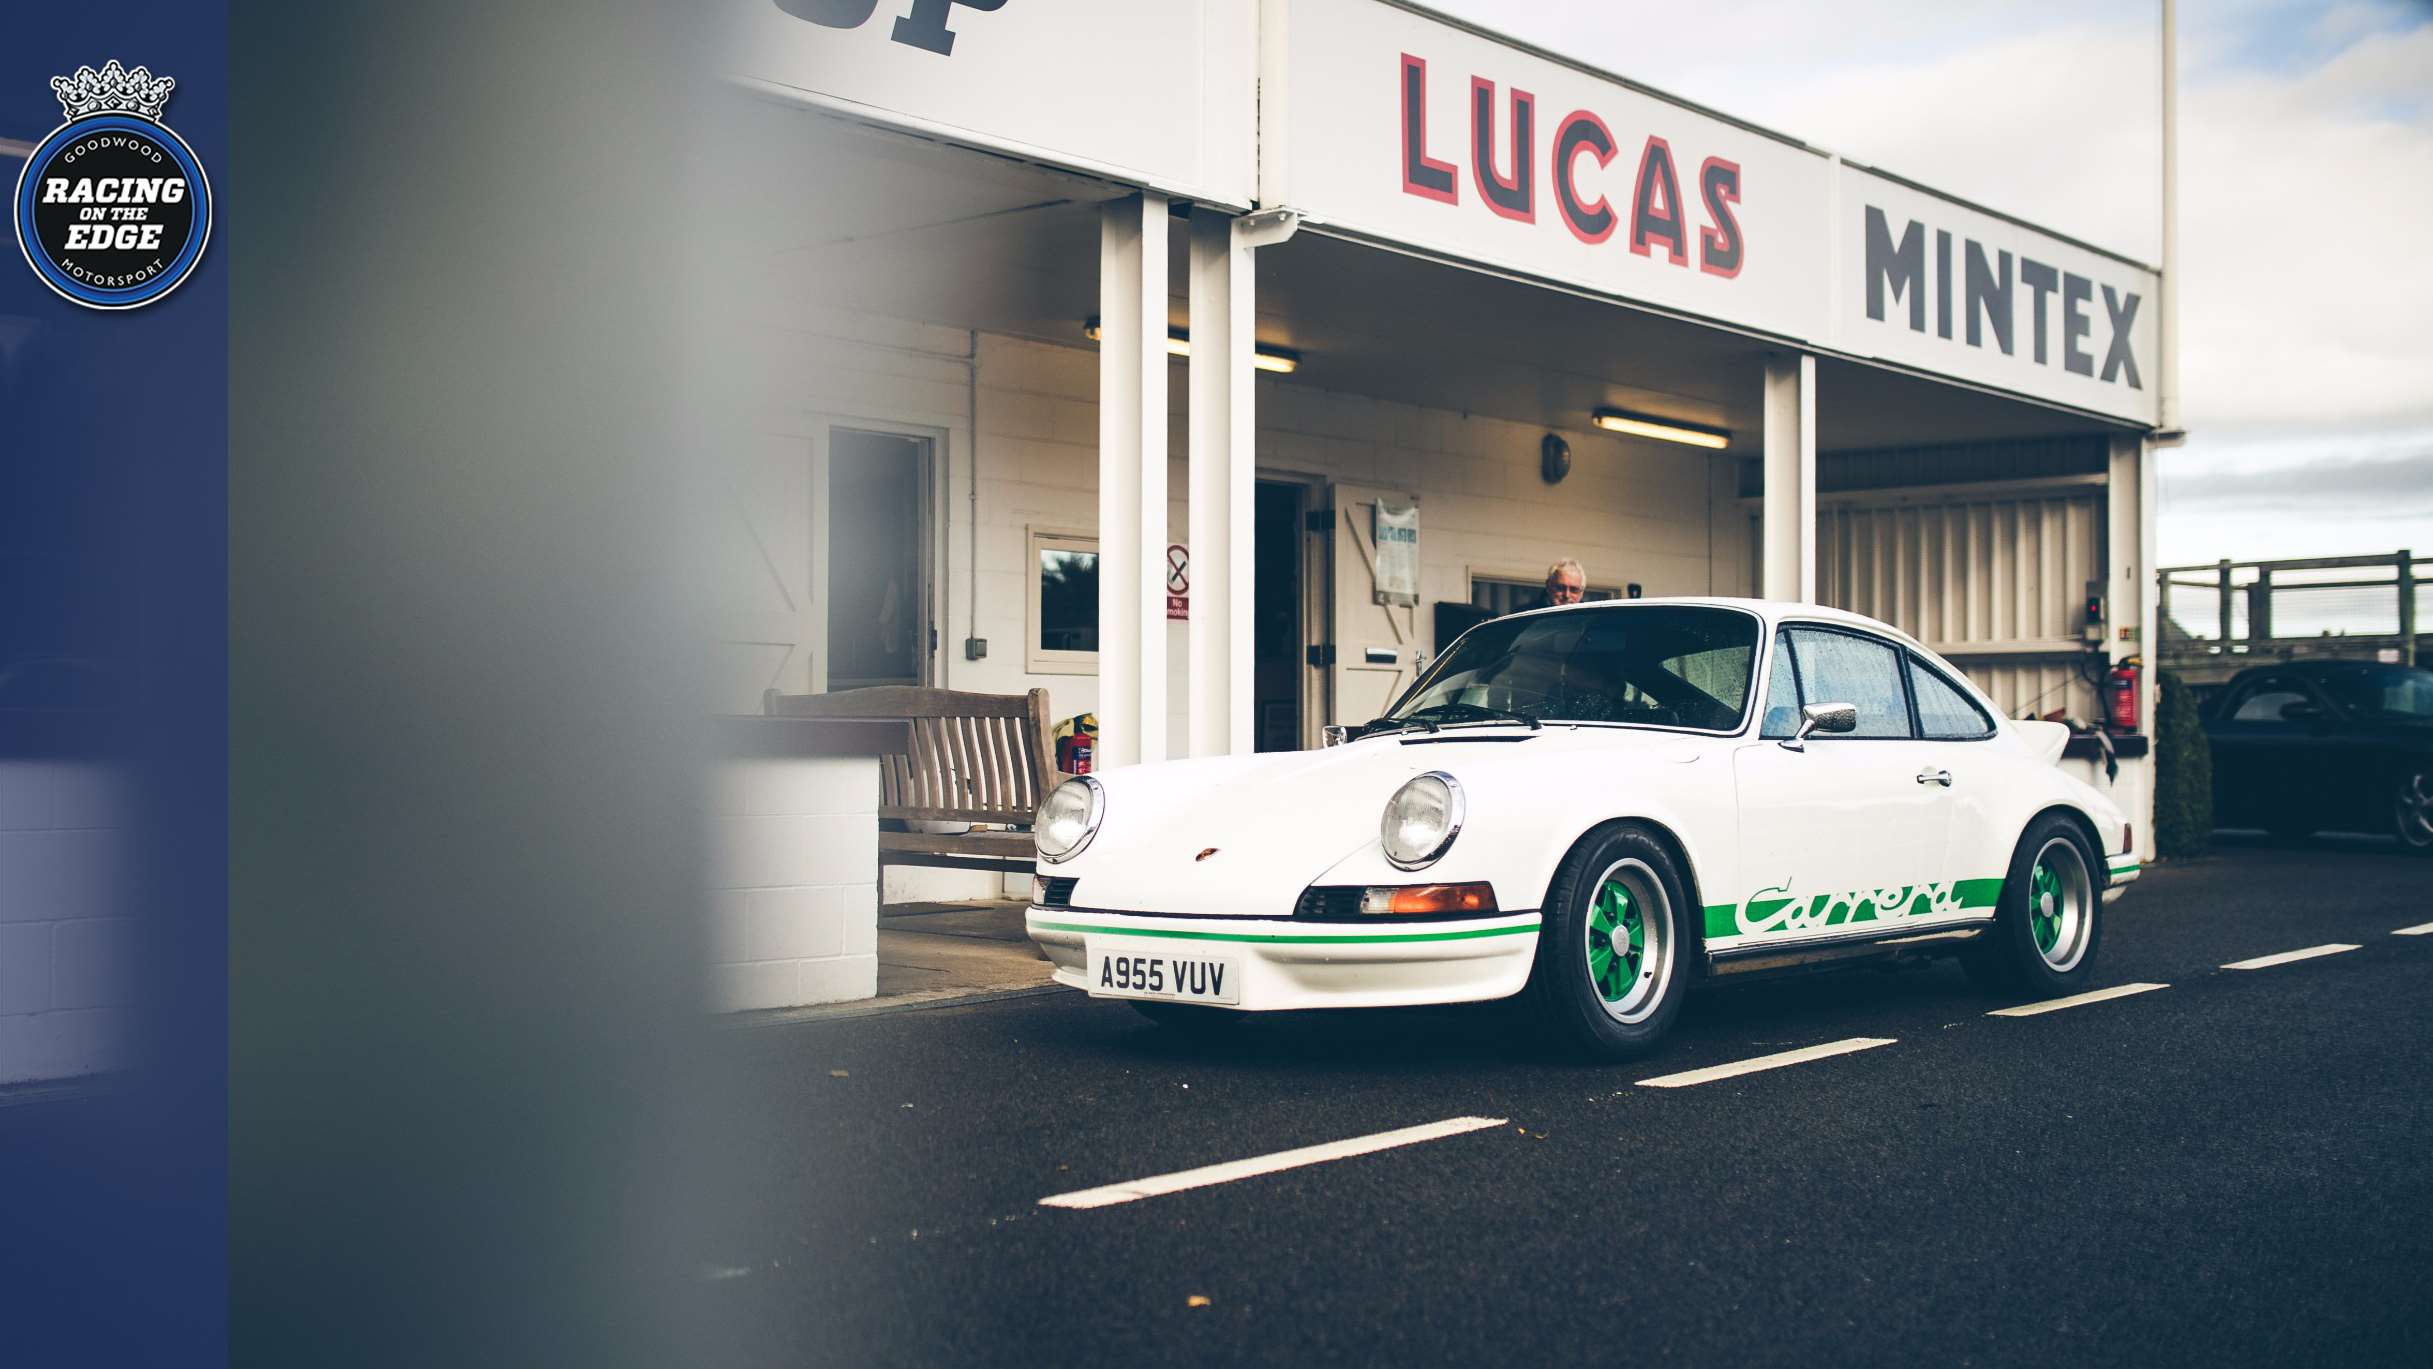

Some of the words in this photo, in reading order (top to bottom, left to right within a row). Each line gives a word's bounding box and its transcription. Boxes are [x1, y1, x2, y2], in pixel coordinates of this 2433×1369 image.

[1400, 52, 1745, 280] LUCAS
[1865, 204, 2143, 391] MINTEX
[1172, 598, 1183, 608] No
[1735, 876, 1964, 935] Carrera
[1101, 956, 1164, 992] A955
[1172, 960, 1225, 996] VUV
